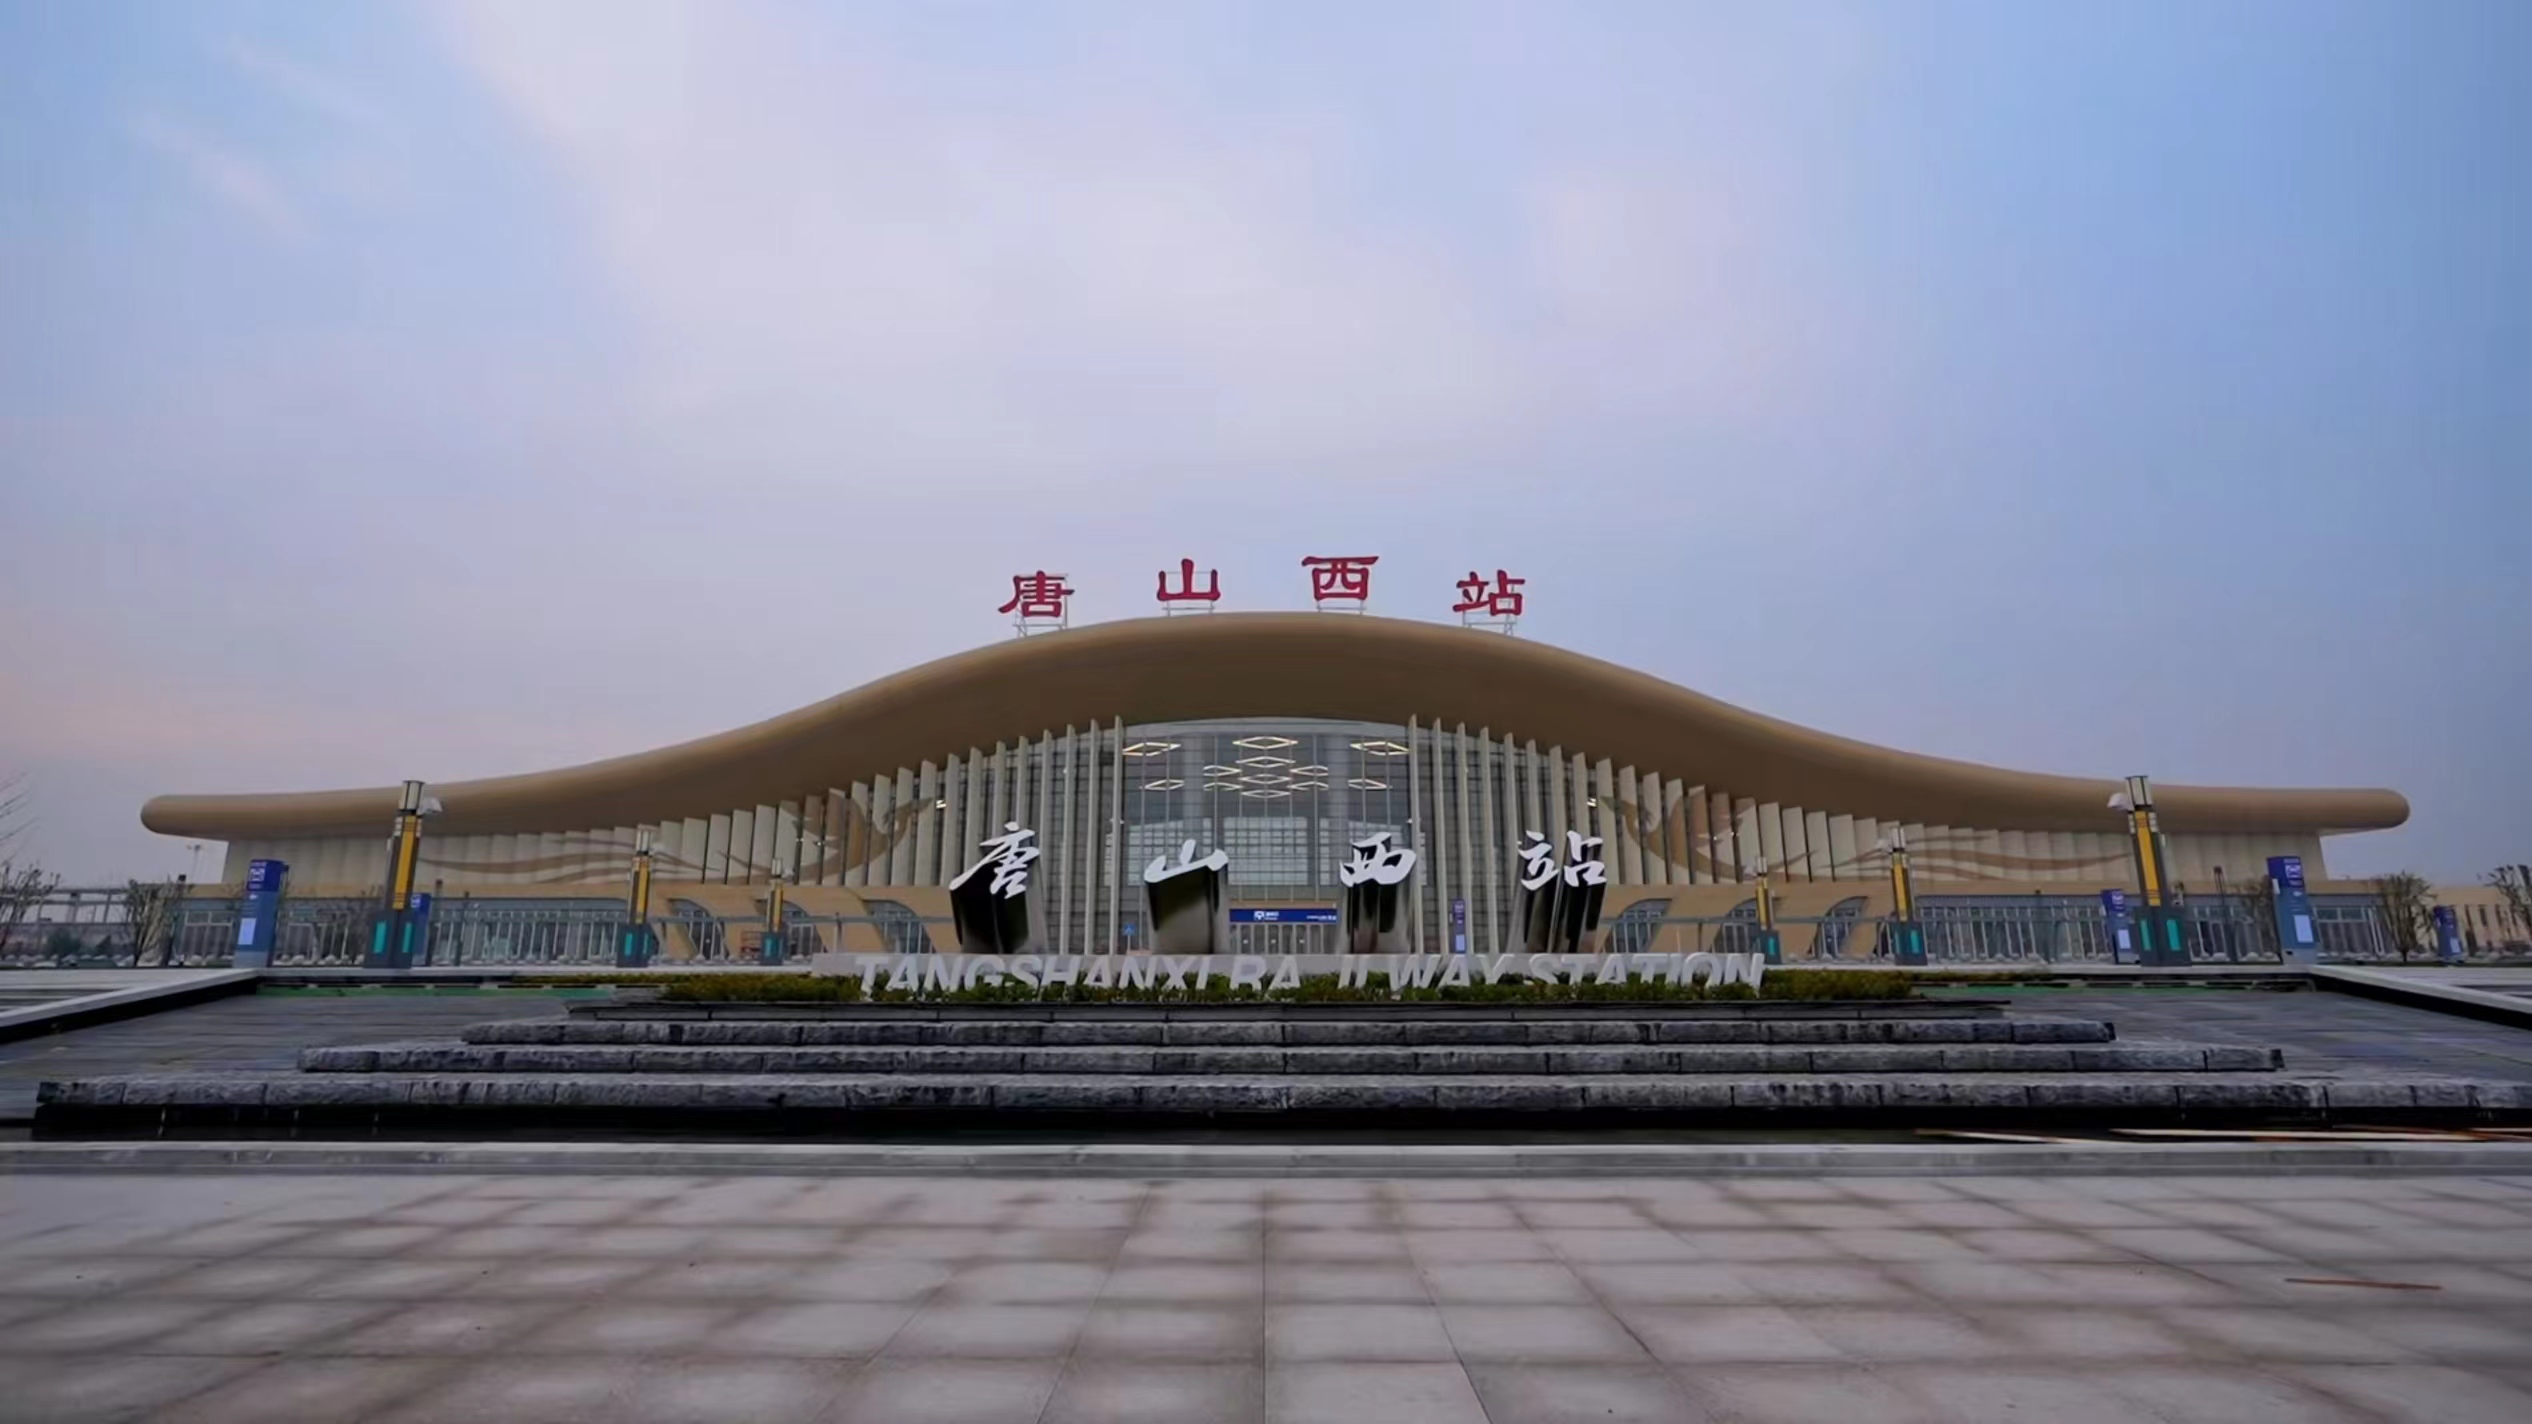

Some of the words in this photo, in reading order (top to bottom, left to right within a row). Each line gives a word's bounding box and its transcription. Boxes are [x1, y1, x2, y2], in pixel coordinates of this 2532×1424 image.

[998, 556, 1526, 618] 唐山西站
[949, 821, 1608, 900] 唐山西站
[855, 954, 1215, 1000] TANGSHANXI
[1524, 952, 1767, 998] STATION
